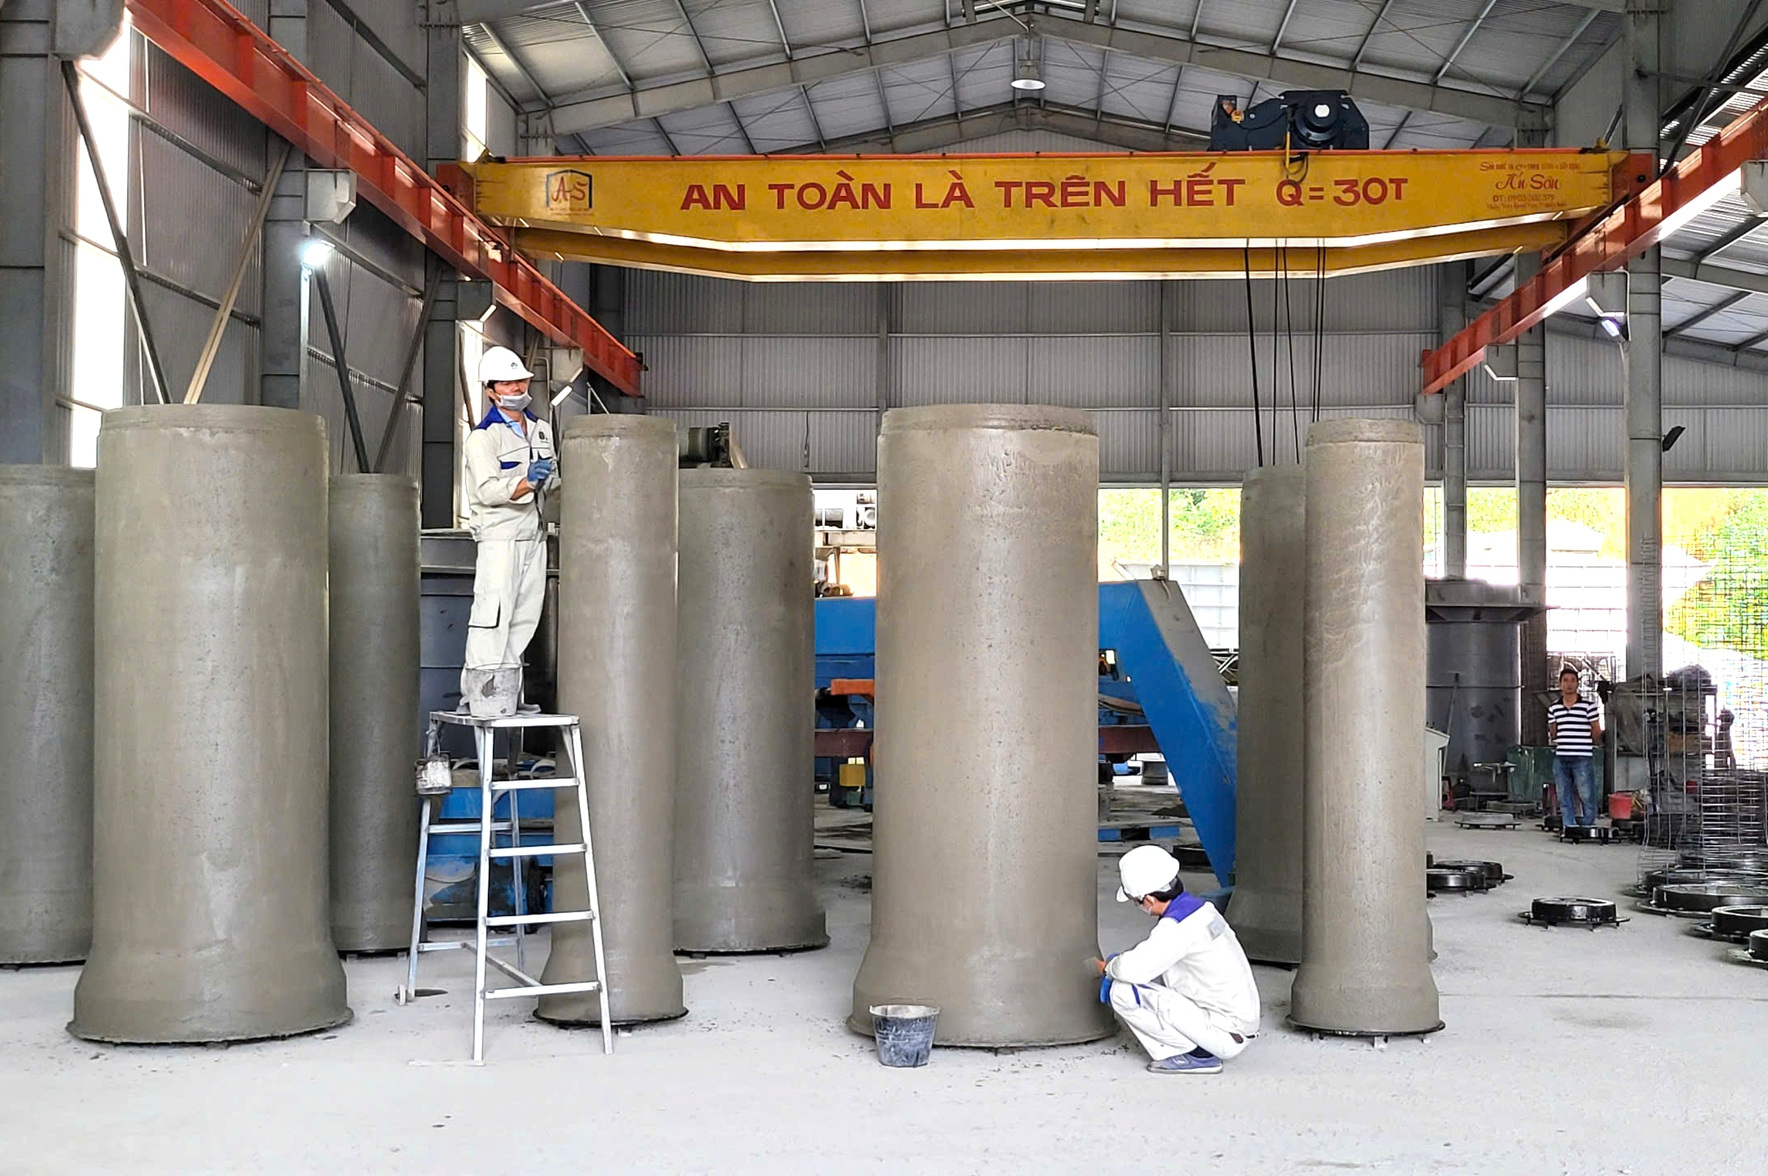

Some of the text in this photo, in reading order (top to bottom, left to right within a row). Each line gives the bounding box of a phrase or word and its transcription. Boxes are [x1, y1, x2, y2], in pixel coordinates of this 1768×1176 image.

[680, 161, 1246, 211] AN TOÀN LÀ TRÊN HẾT
